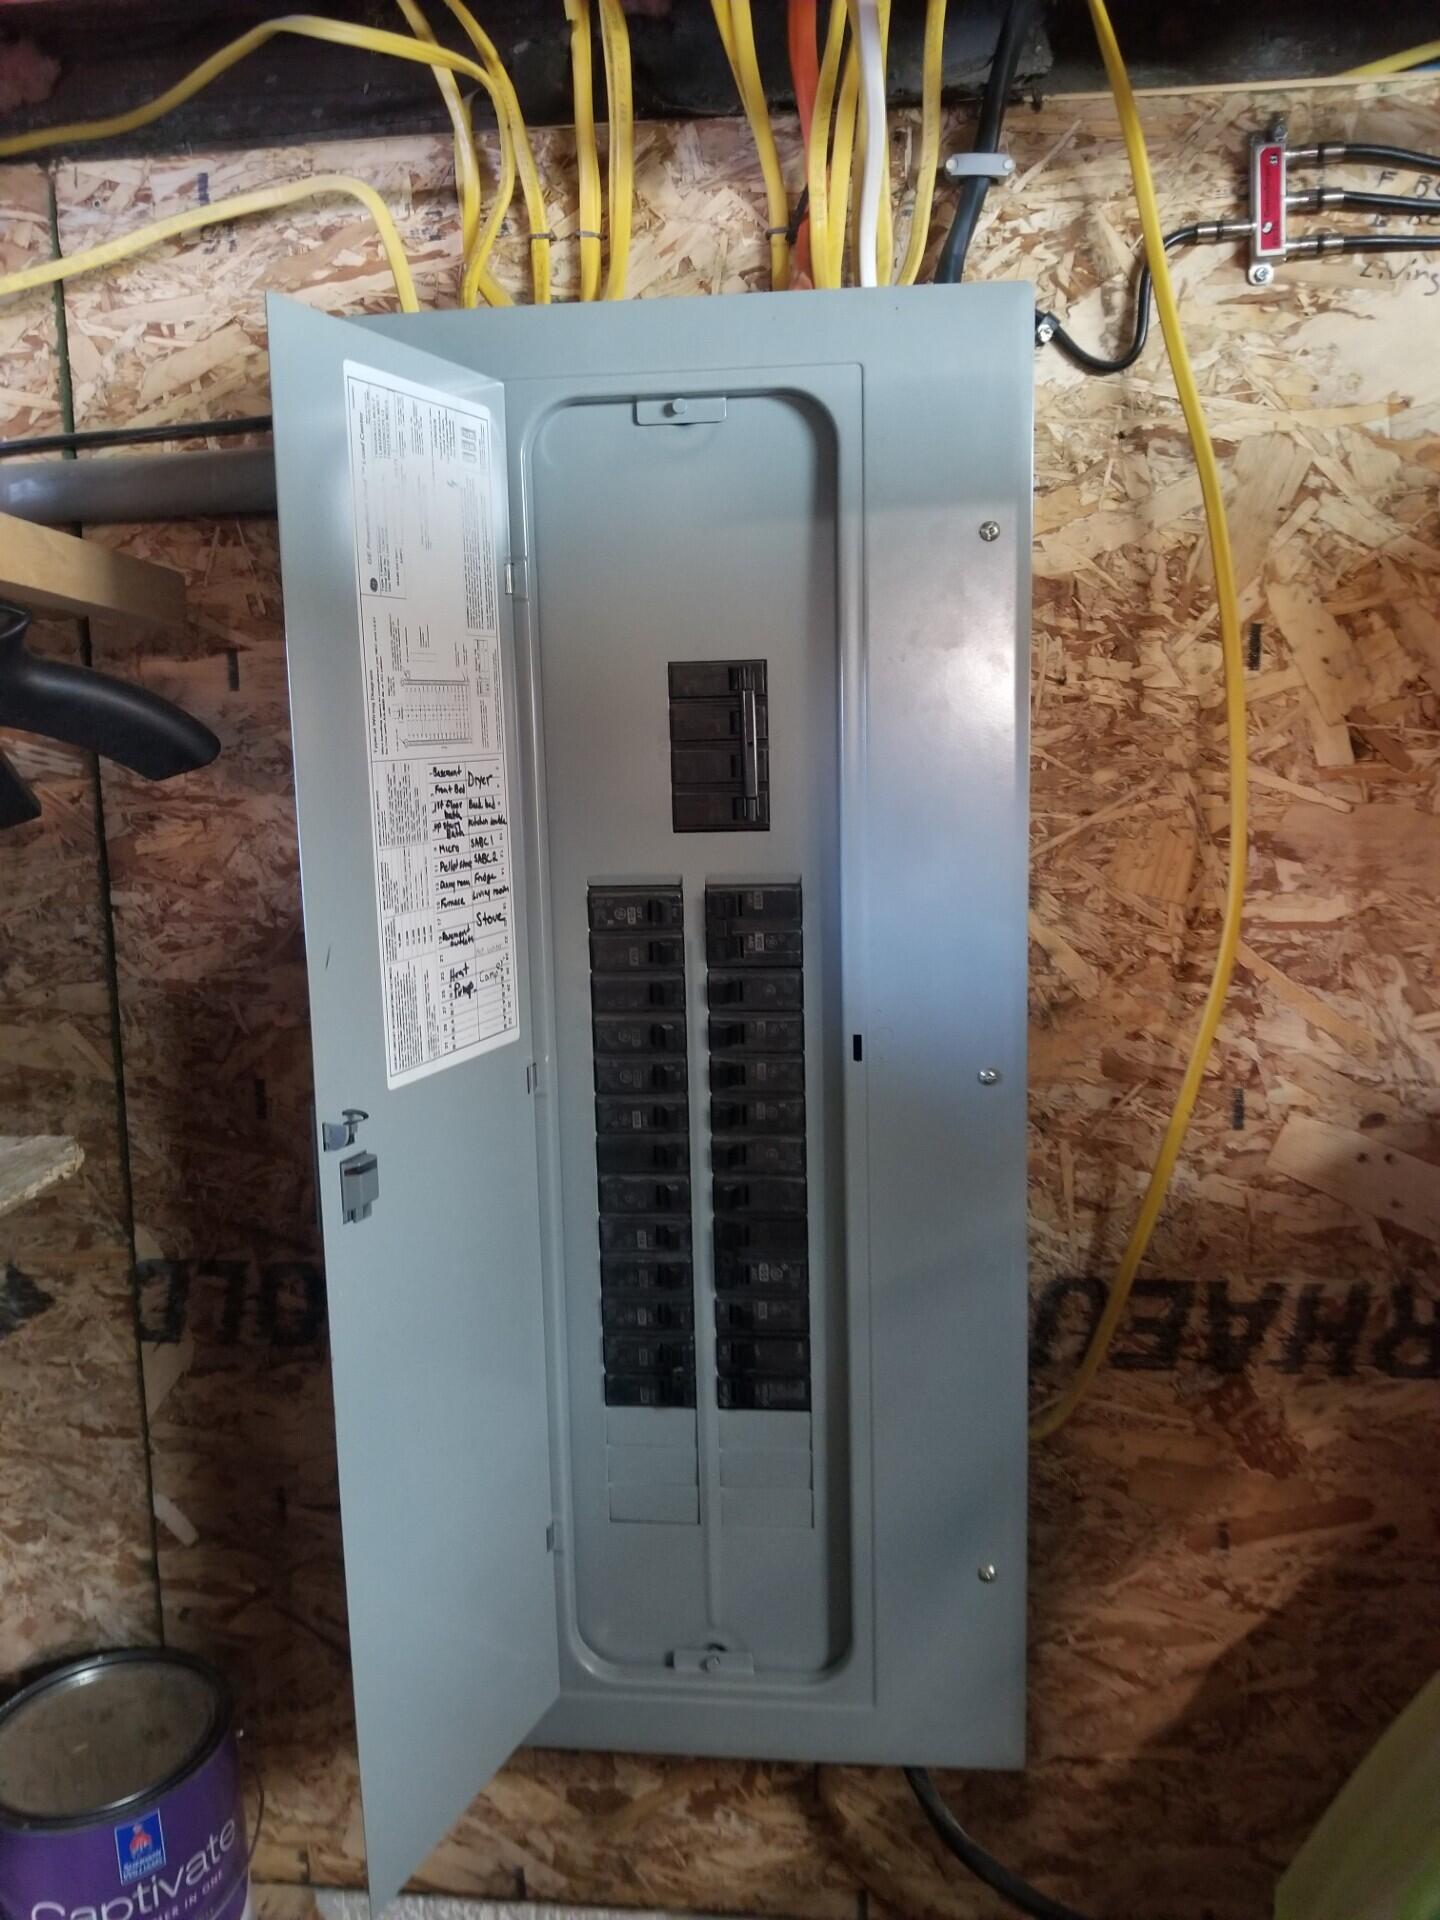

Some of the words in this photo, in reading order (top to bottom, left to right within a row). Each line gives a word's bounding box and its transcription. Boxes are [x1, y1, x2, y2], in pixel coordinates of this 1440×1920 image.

[1359, 257, 1439, 297] Living
[468, 770, 493, 790] Dryer
[439, 844, 460, 855] Micro
[476, 912, 506, 927] Stove
[449, 961, 470, 983] Heat
